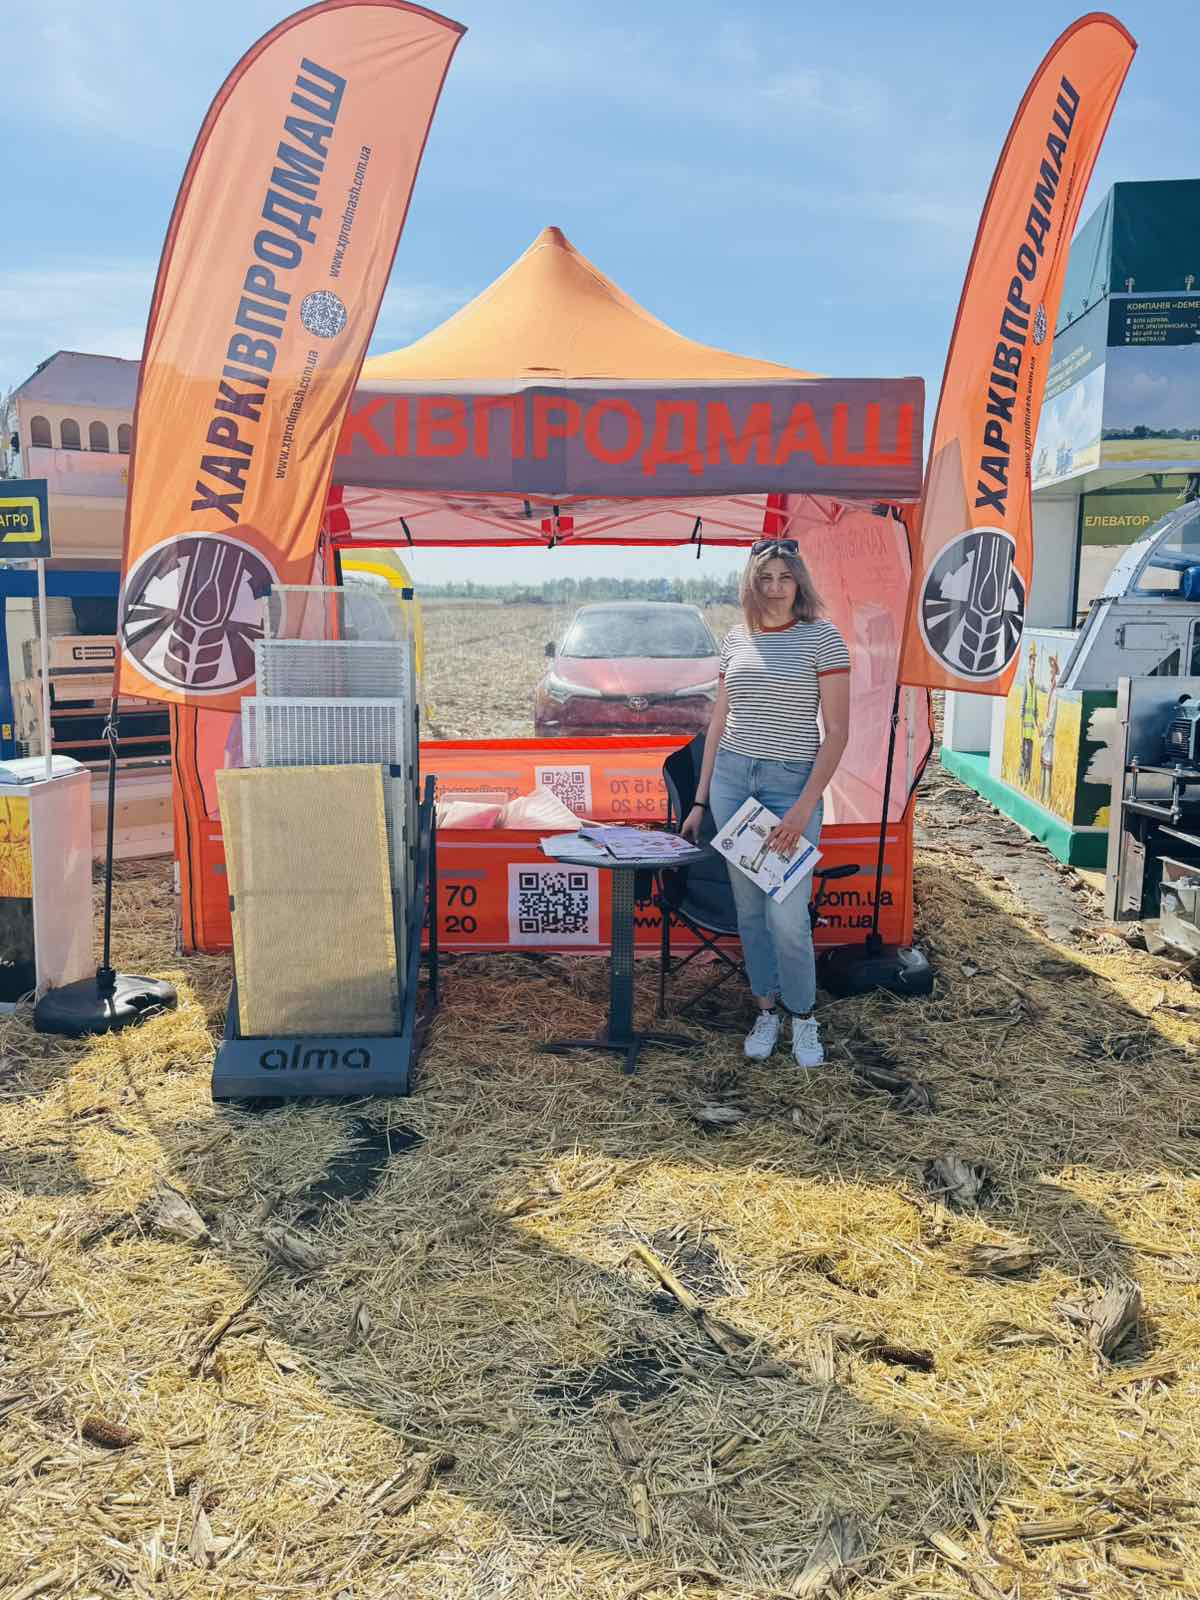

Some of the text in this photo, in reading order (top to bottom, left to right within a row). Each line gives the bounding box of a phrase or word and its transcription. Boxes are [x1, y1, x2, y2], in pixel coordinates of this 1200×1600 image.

[328, 144, 372, 279] www.xprodmash.com.ua
[190, 56, 347, 525] ХАРКІВПРОДМАШ
[975, 74, 1081, 518] ХАРКІВПРОДМАШ
[275, 348, 319, 480] www.xprodmash.com.ua
[1085, 515, 1150, 527] ЕЛЕВАТОР
[445, 884, 478, 907] 70
[445, 915, 478, 933] 20
[259, 1043, 372, 1071] alma
